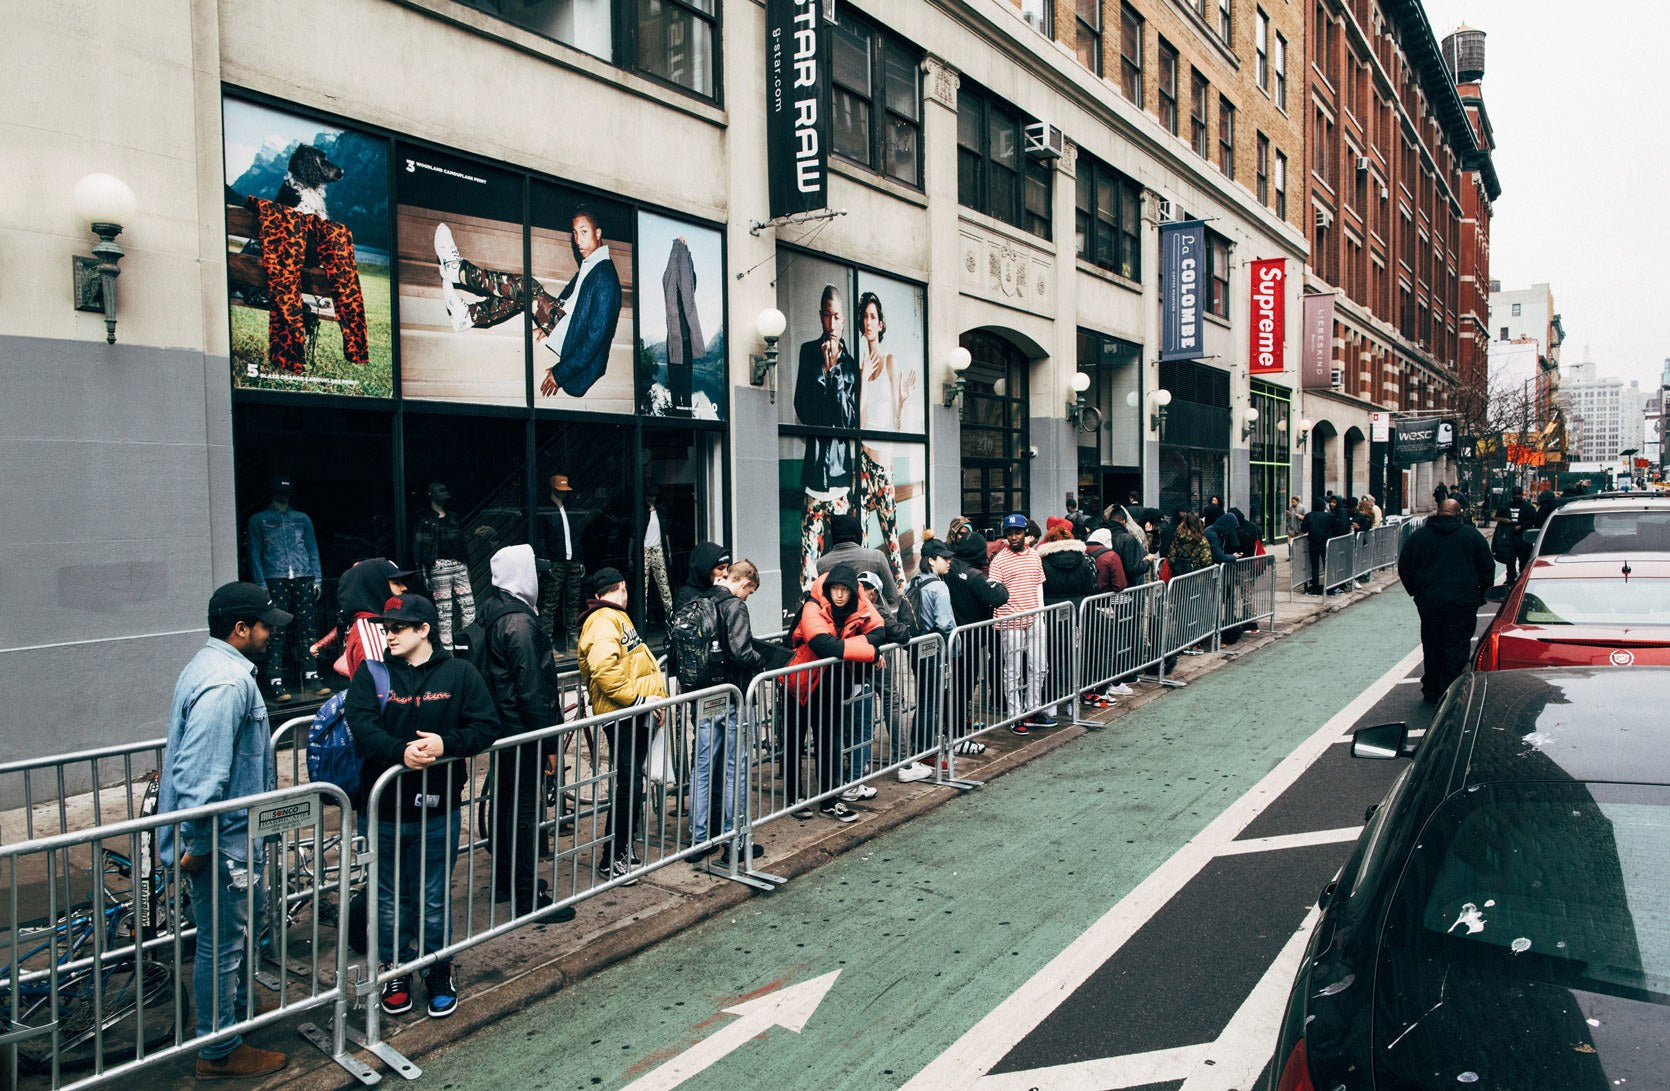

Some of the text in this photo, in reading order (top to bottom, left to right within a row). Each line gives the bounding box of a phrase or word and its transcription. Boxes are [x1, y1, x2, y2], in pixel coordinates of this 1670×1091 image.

[772, 27, 782, 112] g-star.com
[405, 159, 416, 173] 3
[795, 99, 820, 193] RAW
[1181, 235, 1196, 349] La COLOMBE
[1253, 266, 1282, 367] Supreme
[247, 363, 259, 378] 5
[1316, 309, 1325, 375] LIEBESKIND
[782, 608, 788, 618] 7
[272, 806, 299, 818] SONCO
